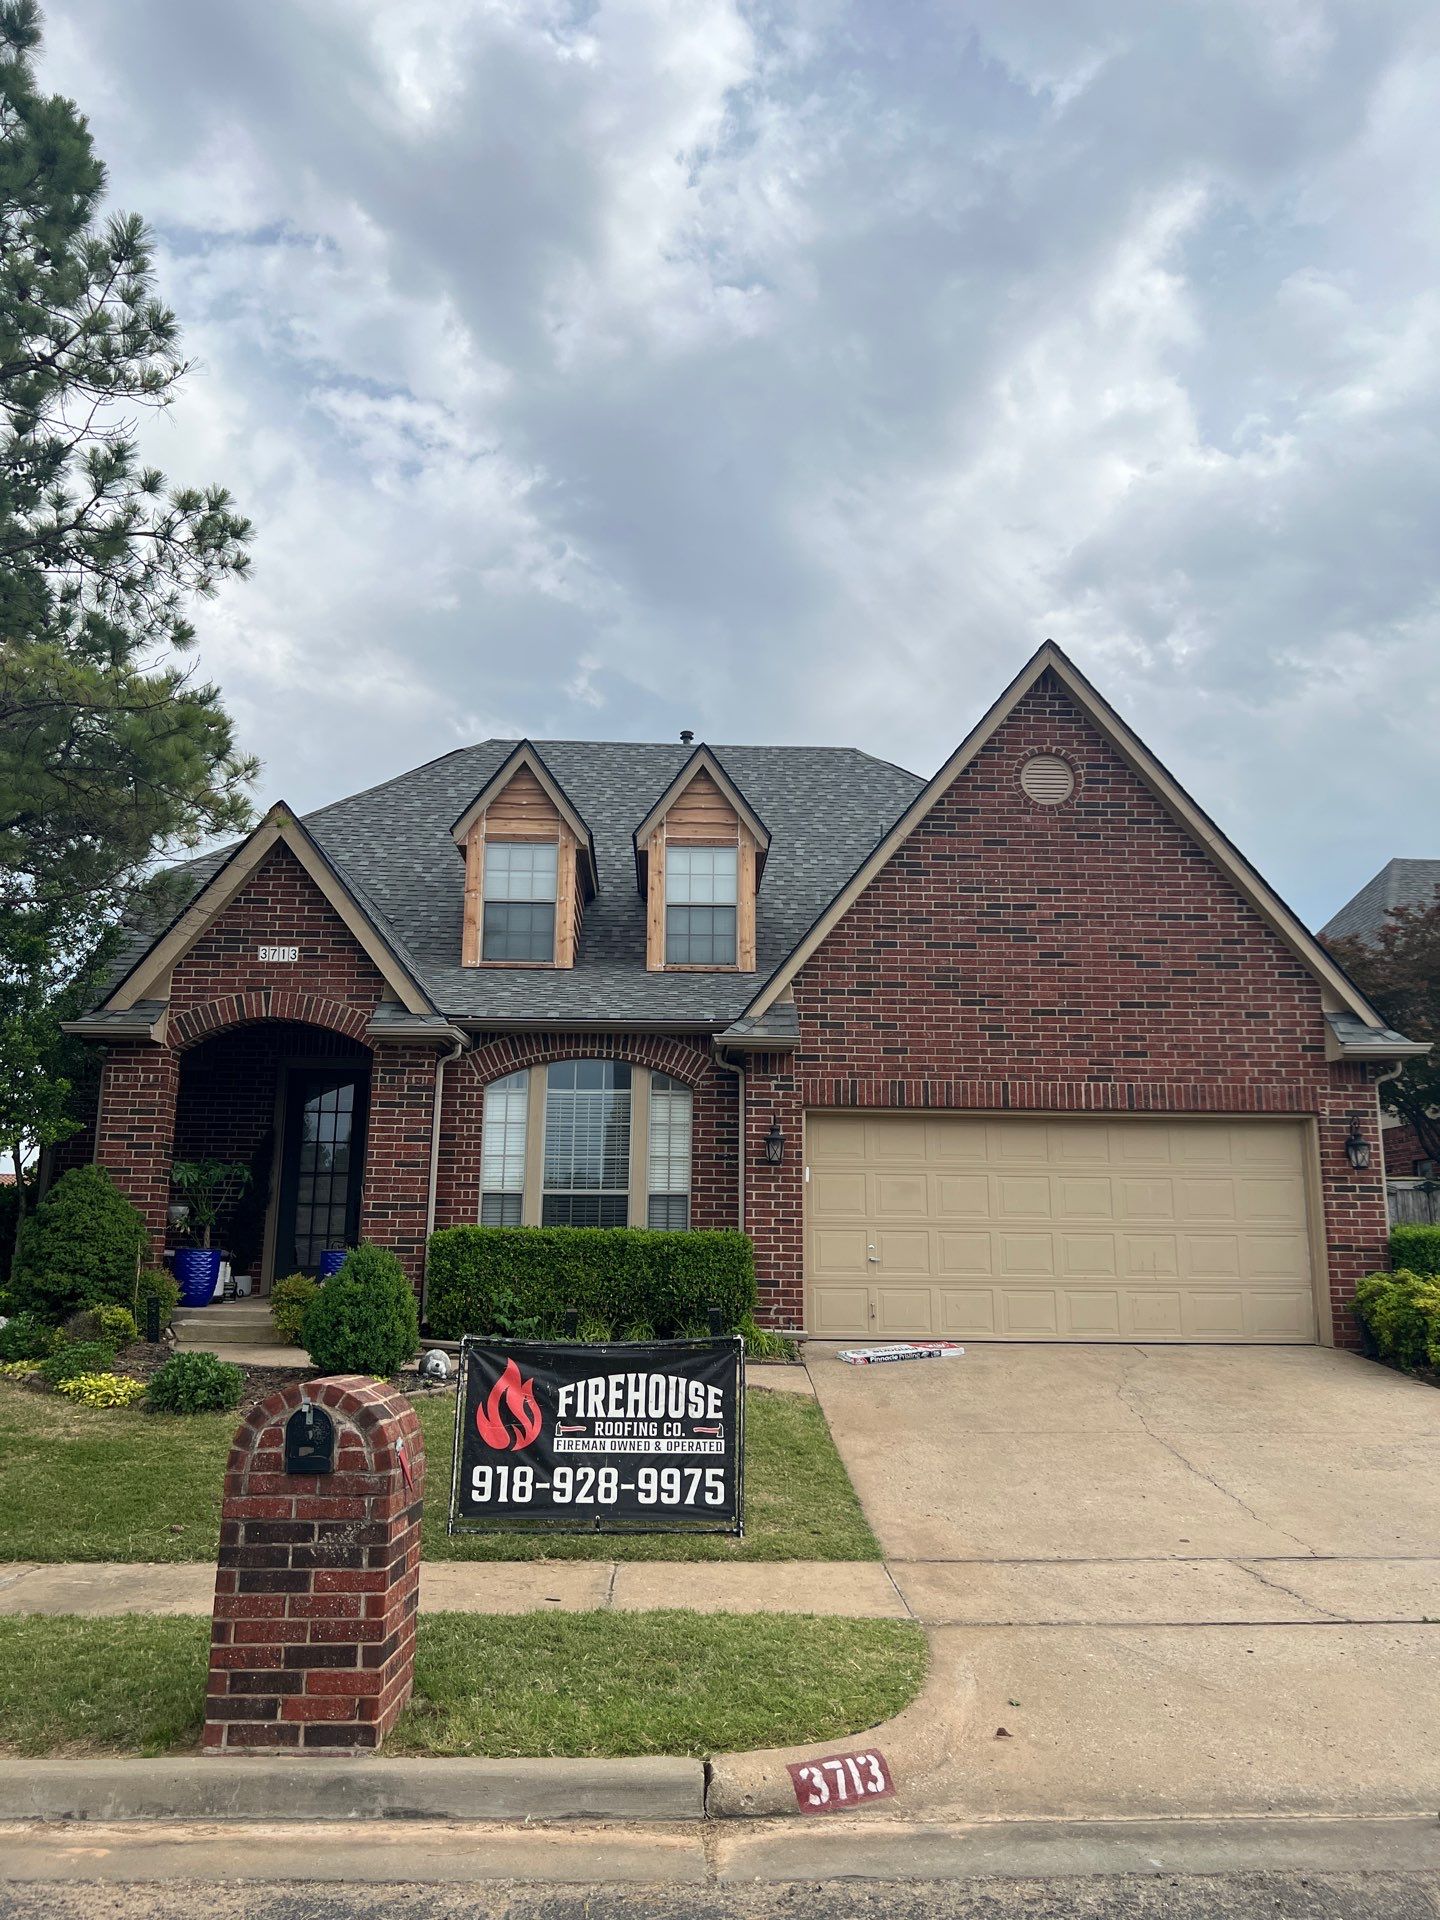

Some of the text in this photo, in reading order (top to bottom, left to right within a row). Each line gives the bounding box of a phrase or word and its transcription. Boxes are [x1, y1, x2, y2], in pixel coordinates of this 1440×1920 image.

[260, 948, 297, 960] 3713
[870, 1353, 899, 1363] Pinnacle
[556, 1373, 724, 1419] FIREHOUSE
[594, 1421, 686, 1437] ROOFING CO.
[556, 1439, 723, 1452] FIREMAN OWNED & OPERATED
[471, 1465, 725, 1505] 918-928-9975
[799, 1754, 885, 1806] 3713
